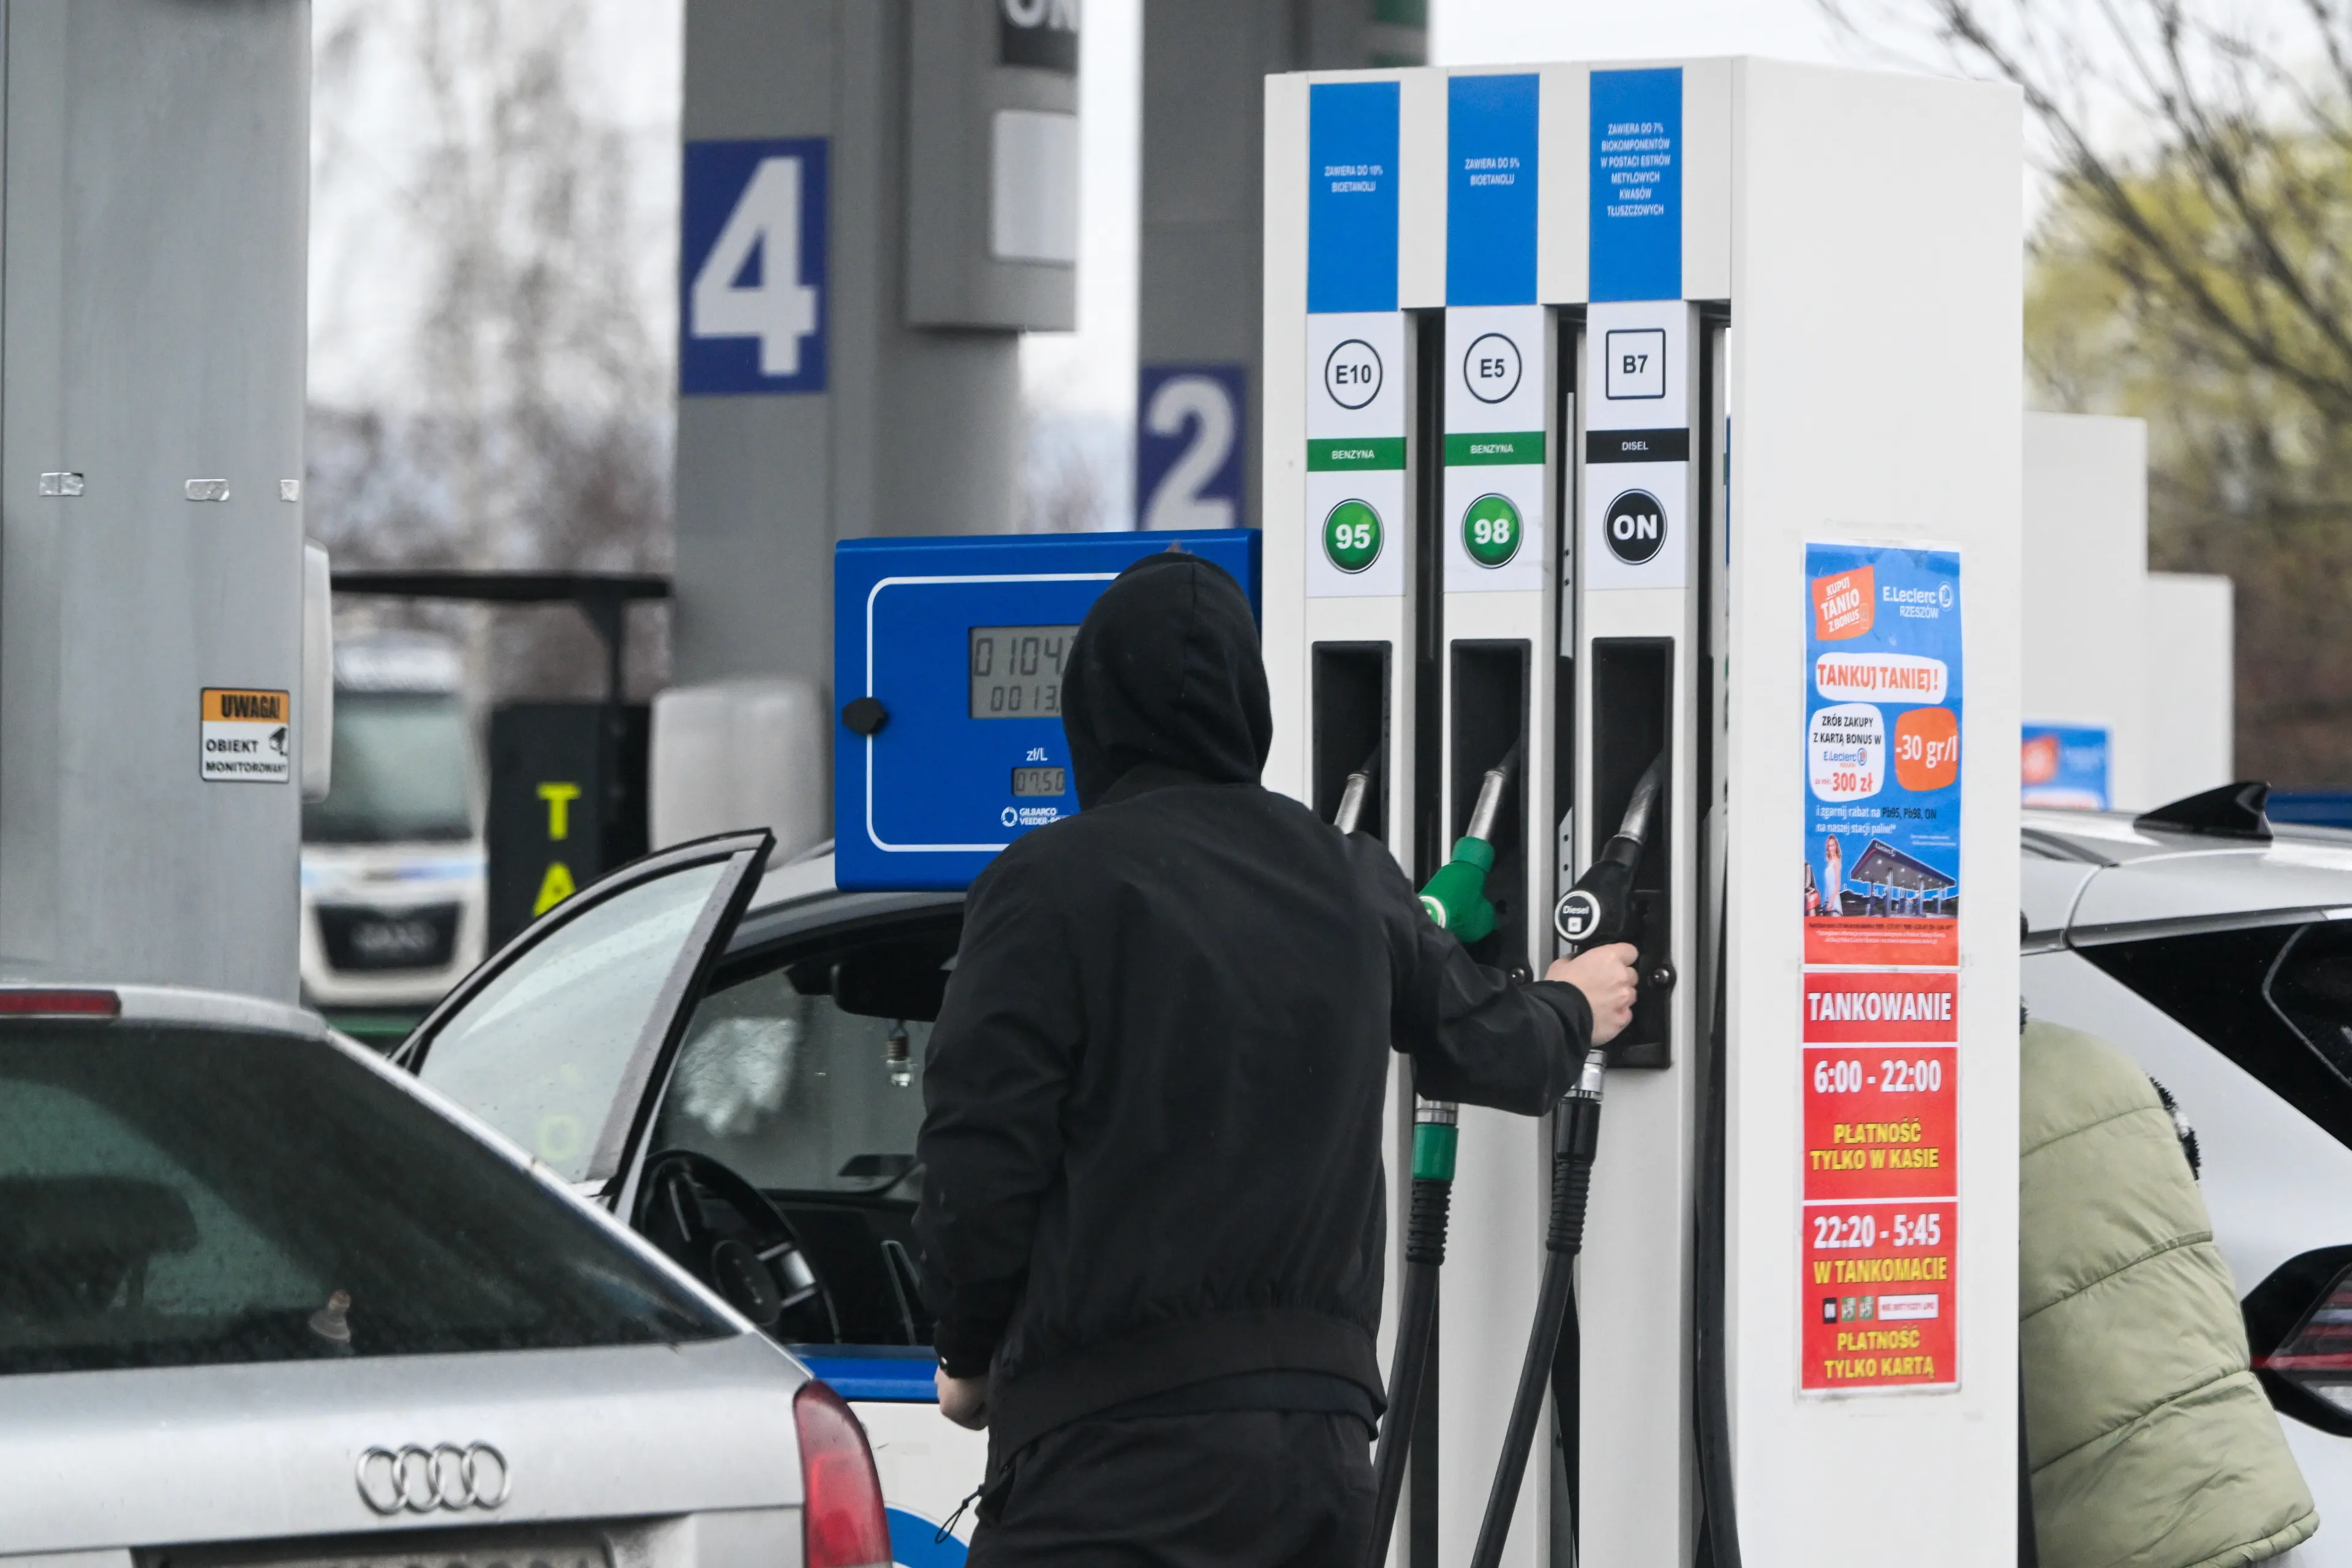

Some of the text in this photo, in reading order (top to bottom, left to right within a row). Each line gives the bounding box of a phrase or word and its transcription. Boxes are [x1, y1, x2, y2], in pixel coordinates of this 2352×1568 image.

[1608, 122, 1664, 135] ZAWIERA DO 7%
[1602, 137, 1670, 152] BIOKOMPONENTÓW
[1464, 157, 1520, 170] ZAWIERA DO 5%
[1600, 153, 1671, 168] W POSTACI ESTRÓW
[1324, 165, 1355, 177] ZAWIERA
[1357, 165, 1368, 176] DO
[1611, 171, 1660, 184] METYLOWYCH
[1332, 181, 1376, 192] BIOETANOLU
[1470, 173, 1515, 186] BIOETANOLU
[1619, 185, 1652, 200] KWASÓW
[1607, 204, 1664, 217] TŁUSZCZOWYCH
[690, 156, 818, 376] 4
[1480, 358, 1506, 378] E5
[1623, 355, 1648, 374] B7
[1335, 364, 1371, 385] E10
[1145, 375, 1235, 530] 2
[1470, 443, 1513, 454] BENZYNA
[1621, 440, 1649, 451] DISEL
[1332, 450, 1375, 460] BENZYNA
[1474, 518, 1510, 545] 98
[1613, 514, 1658, 540] ON
[1335, 523, 1371, 549] 95
[1825, 577, 1850, 597] KUPUJ
[1882, 586, 1937, 604] E.Leclerc
[1820, 588, 1860, 621] TANIO
[1899, 605, 1939, 619] RZESZÓW
[974, 637, 1076, 676] 0104
[1817, 664, 1877, 691] TANKUJ
[1822, 714, 1873, 728] ZRÓB ZAKUPY
[206, 739, 258, 753] OBIEKT
[1813, 733, 1882, 746] Z KARTĄ BONUS W
[1026, 747, 1049, 761] zł/L
[1823, 751, 1856, 763] E.Leclerc
[1926, 735, 1958, 768] gr/l
[206, 761, 288, 774] MONITOROWANY
[1833, 772, 1856, 791] 300
[1860, 772, 1873, 792] zł
[1019, 807, 1058, 816] GILBARCO
[1821, 805, 1847, 820] zgarnij
[1849, 806, 1870, 817] rabat
[1882, 807, 1902, 820] Pb95,
[1904, 807, 1923, 820] Pb98,
[1925, 809, 1937, 819] ON
[1827, 823, 1850, 835] naszej
[1851, 823, 1871, 835] stacji
[1562, 905, 1590, 914] Diesel
[1808, 992, 1951, 1021] TANKOWANIE
[1814, 1060, 1863, 1093] 6:00
[1880, 1059, 1942, 1092] 22:00
[1834, 1117, 1921, 1144] PŁATNOŚĆ
[1810, 1147, 1939, 1170] TYLKO W KASIE
[1814, 1215, 1875, 1249] 22:20
[1893, 1213, 1941, 1247] 5:45
[1813, 1256, 1947, 1284] W TANKOMACIE
[1837, 1325, 1921, 1351] PŁATNOŚĆ
[1824, 1355, 1935, 1379] TYLKO KARTĄ
